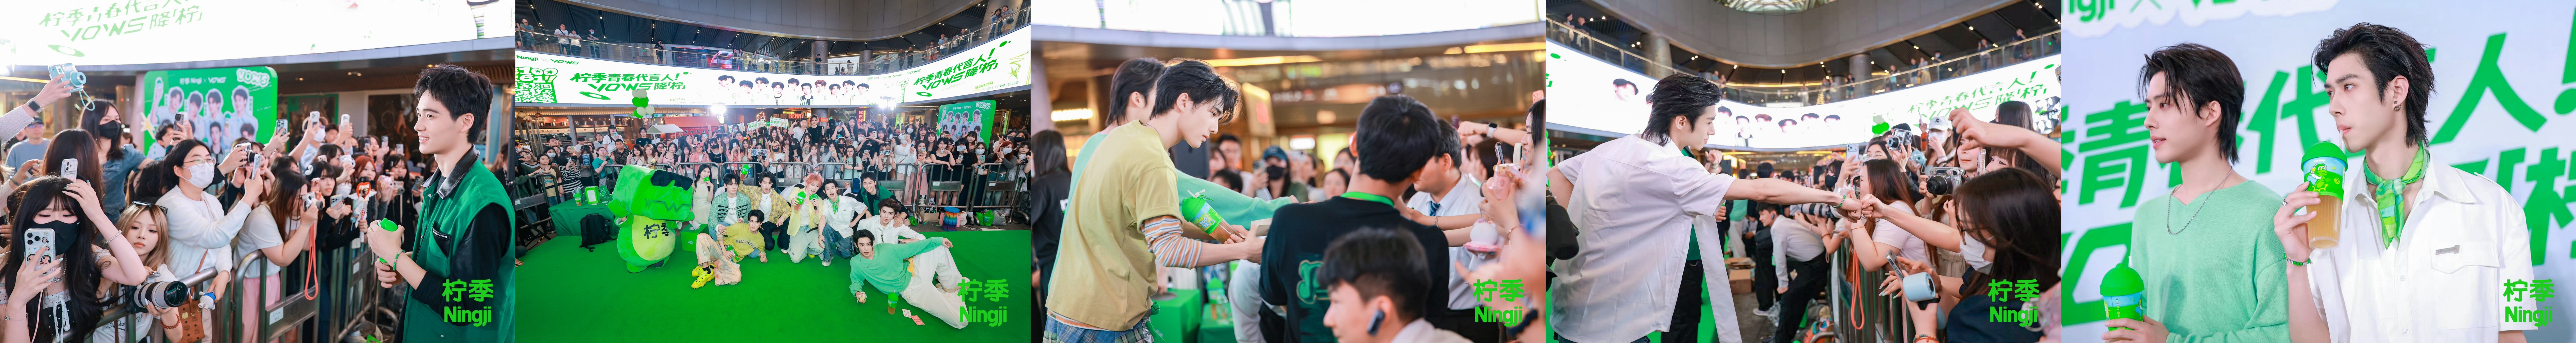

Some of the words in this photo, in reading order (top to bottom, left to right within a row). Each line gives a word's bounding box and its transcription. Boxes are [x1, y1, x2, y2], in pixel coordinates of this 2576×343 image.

[61, 16, 147, 42] VOWS
[237, 68, 270, 87] VOWS
[922, 71, 965, 91] VOWS
[587, 82, 653, 92] VOWS
[644, 223, 670, 240] 柠季
[736, 240, 758, 250] RANDOMEVEN
